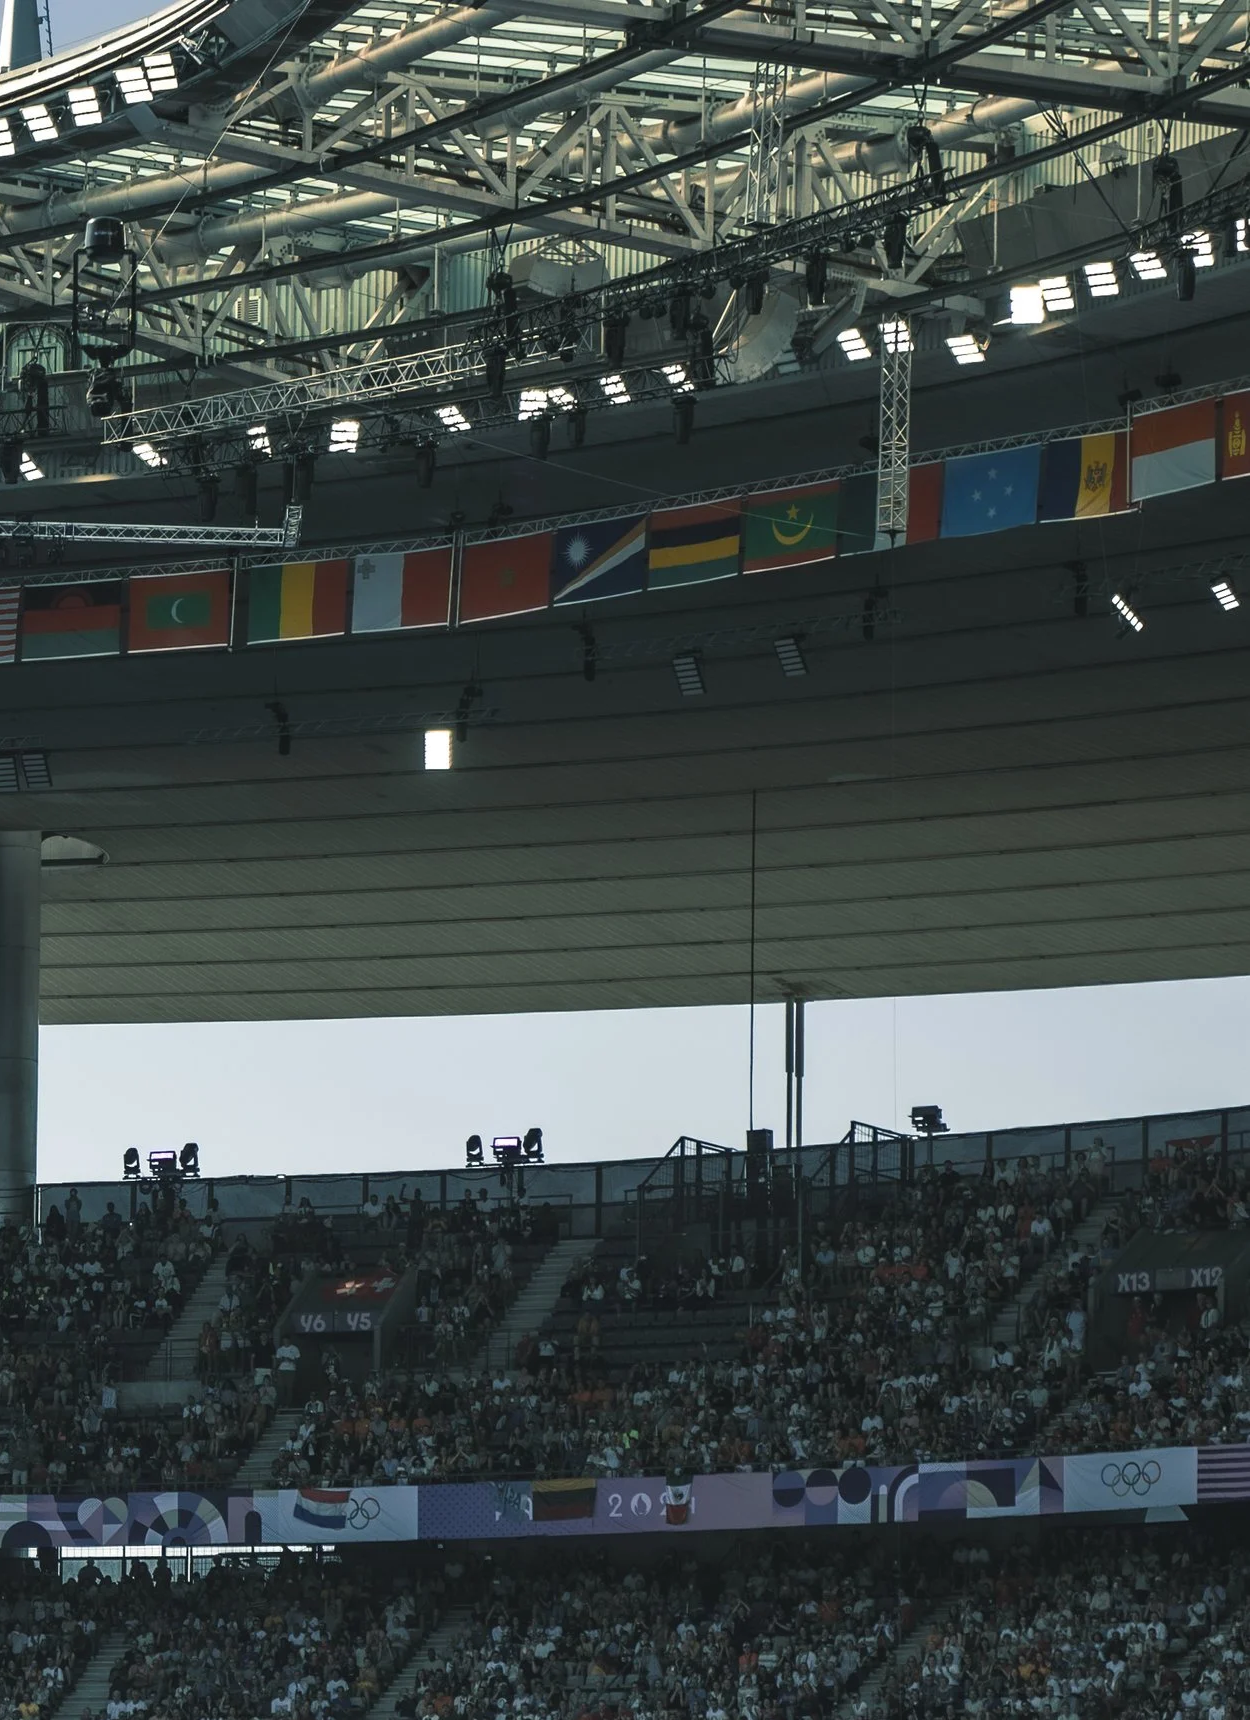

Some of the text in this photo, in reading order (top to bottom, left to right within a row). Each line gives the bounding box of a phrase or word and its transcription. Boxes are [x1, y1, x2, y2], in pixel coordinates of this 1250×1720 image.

[1117, 1271, 1150, 1293] X13
[300, 1312, 371, 1332] Y6 Y5
